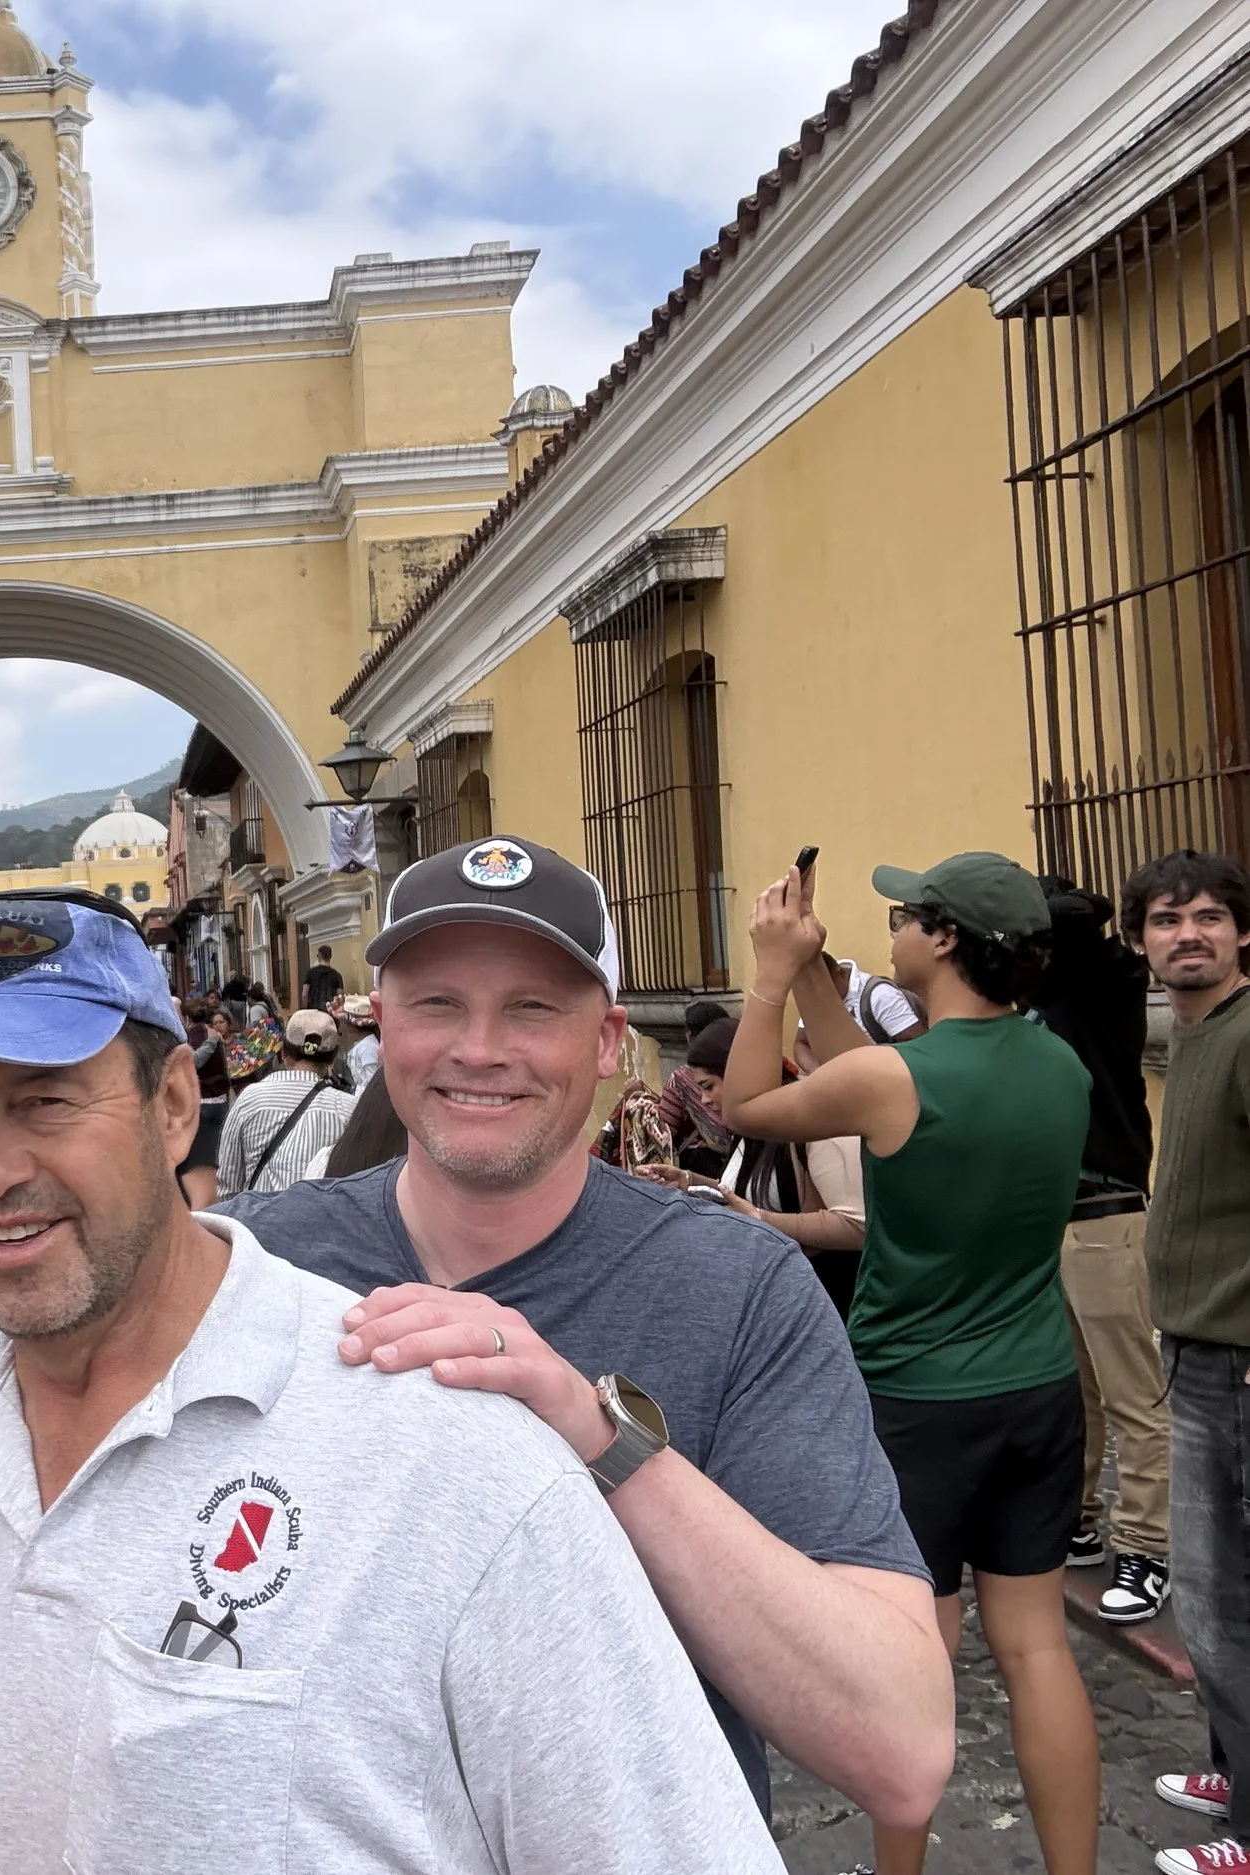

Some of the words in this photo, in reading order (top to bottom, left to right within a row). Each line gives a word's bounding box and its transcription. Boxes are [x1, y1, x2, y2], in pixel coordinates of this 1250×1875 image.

[197, 1478, 246, 1524] Southern
[250, 1471, 292, 1506] Indiana
[285, 1506, 303, 1551] Scuba
[190, 1543, 215, 1600] Diving
[217, 1566, 291, 1610] Specialists
